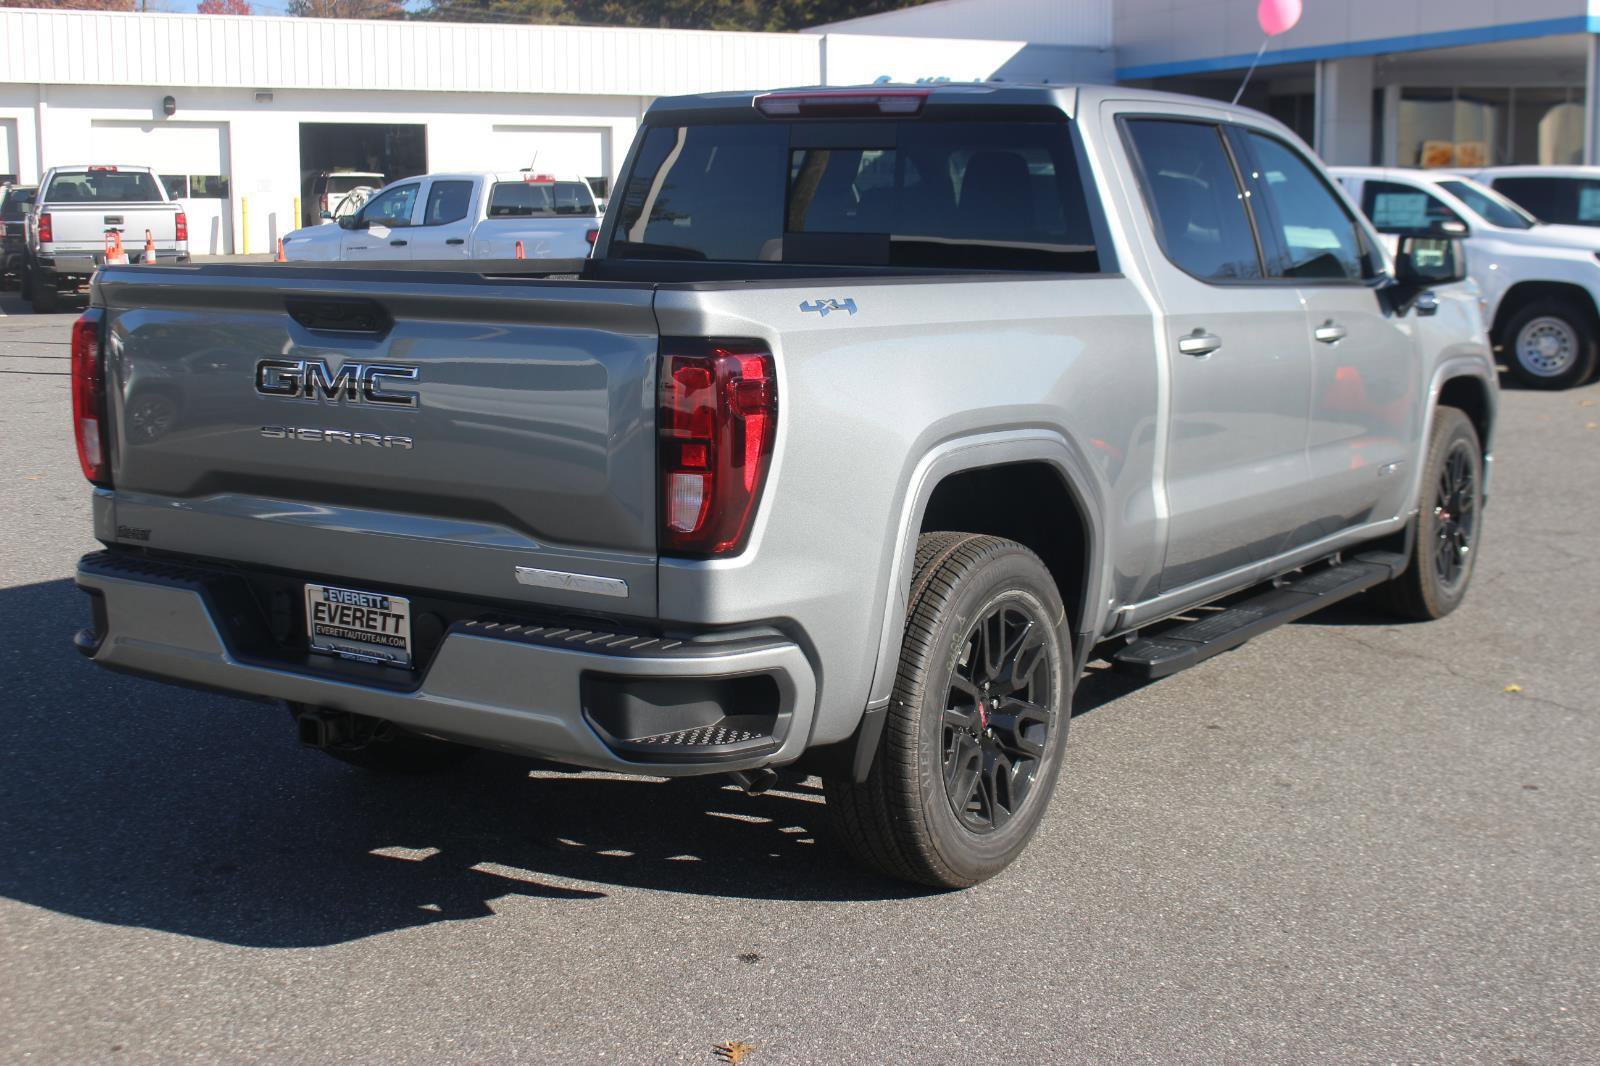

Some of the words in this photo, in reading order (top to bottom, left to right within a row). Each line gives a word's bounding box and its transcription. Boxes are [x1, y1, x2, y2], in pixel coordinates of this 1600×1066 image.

[255, 358, 420, 410] GMC
[260, 425, 414, 450] SIERRA
[328, 588, 383, 609] EVERETT
[313, 601, 405, 634] EVERETT
[315, 625, 407, 648] EVERETTAUTOTEAM.COM
